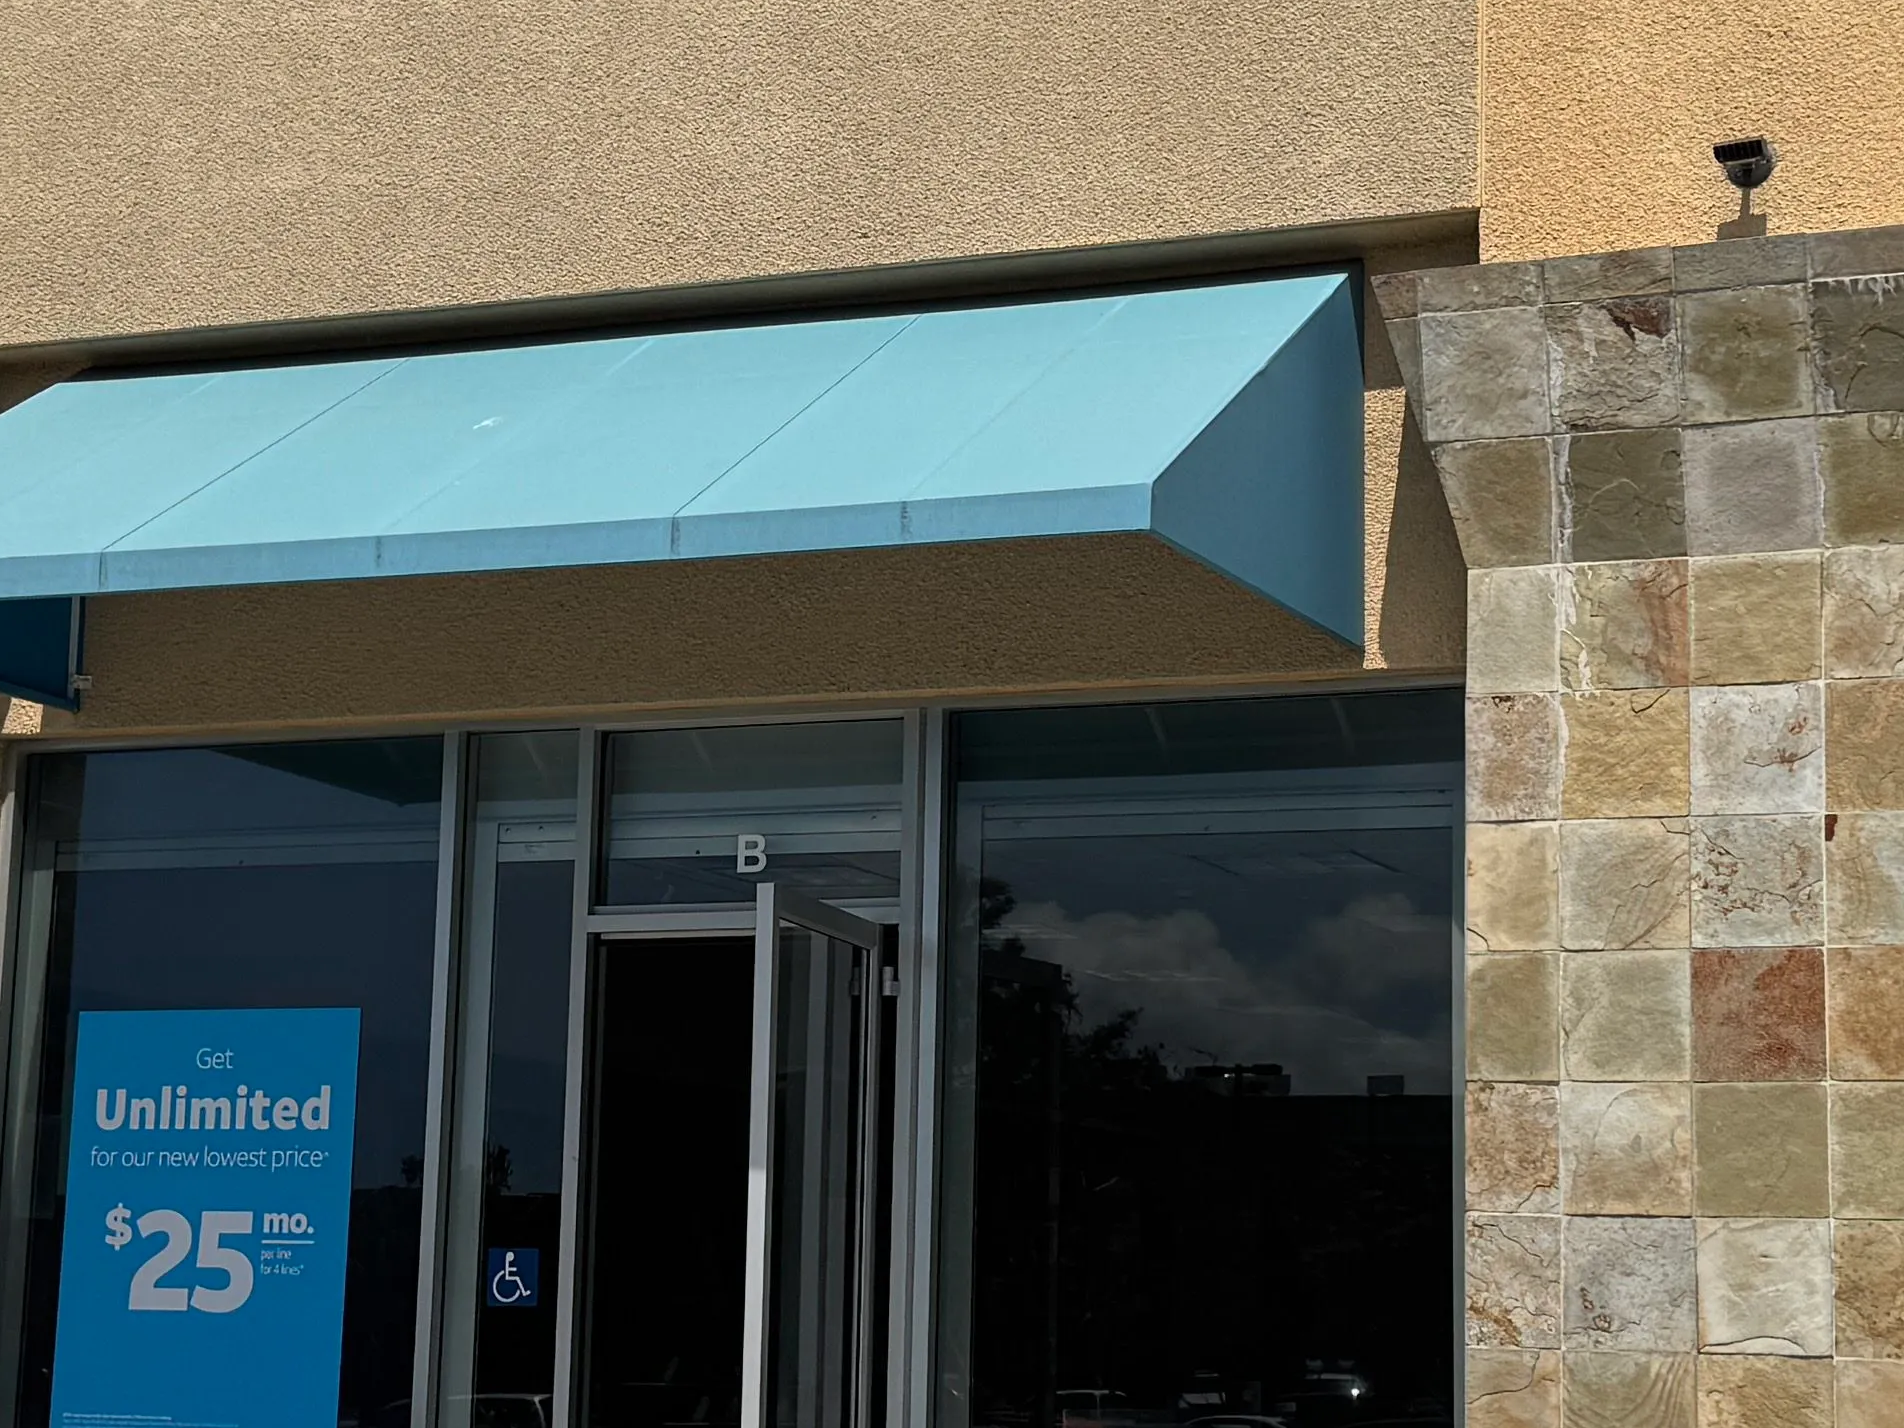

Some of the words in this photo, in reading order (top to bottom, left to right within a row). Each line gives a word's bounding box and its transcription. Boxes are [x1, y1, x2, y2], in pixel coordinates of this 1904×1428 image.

[737, 834, 767, 873] B
[196, 1047, 234, 1069] Get
[95, 1084, 331, 1130] Unlimited
[90, 1145, 118, 1168] for
[121, 1151, 154, 1167] our
[159, 1151, 199, 1167] new
[203, 1145, 267, 1168] lowest
[262, 1212, 315, 1234] mo.
[105, 1203, 255, 1313] $25
[260, 1249, 274, 1261] per
[276, 1247, 292, 1260] line
[260, 1263, 272, 1275] for
[273, 1263, 280, 1275] 4
